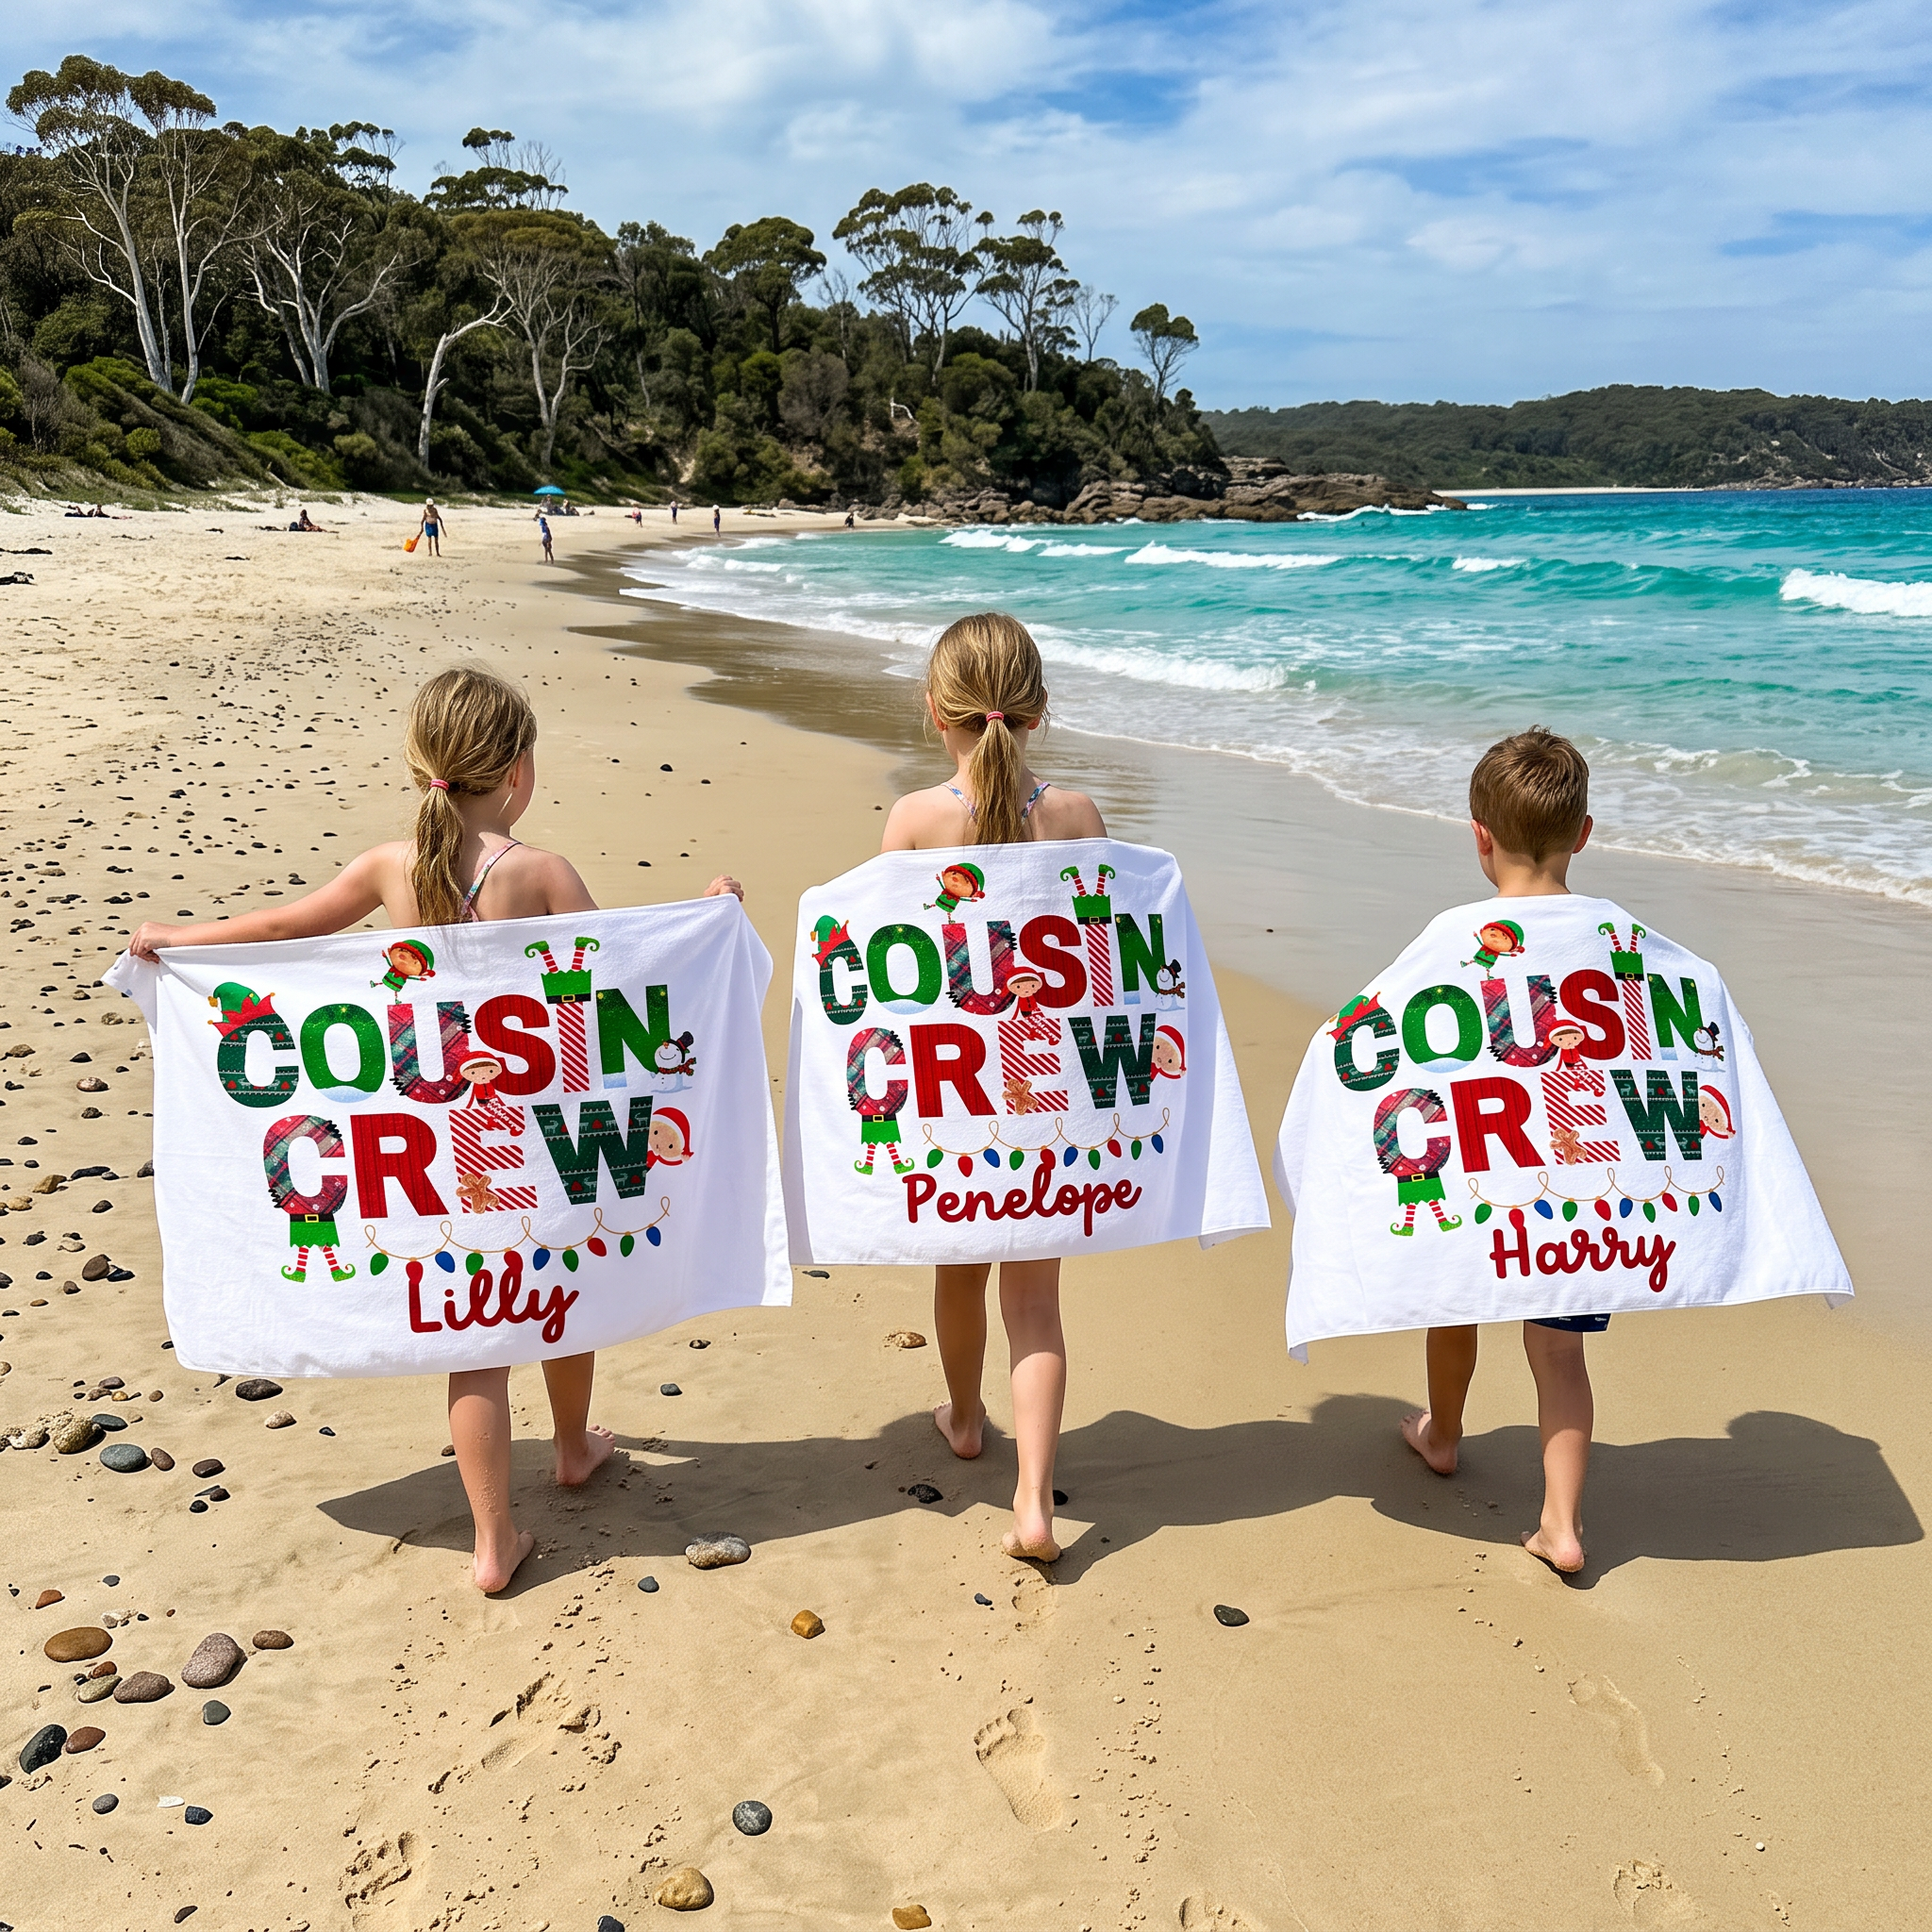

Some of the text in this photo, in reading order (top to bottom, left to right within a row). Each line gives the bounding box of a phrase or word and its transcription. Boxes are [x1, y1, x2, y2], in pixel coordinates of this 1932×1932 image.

[819, 913, 1166, 1025] COUSIN
[217, 985, 672, 1108] COUSIN
[847, 1013, 1157, 1118] CREW
[1334, 969, 1702, 1091] COUSIN
[263, 1095, 653, 1220] CREW
[1374, 1069, 1703, 1176] CREW
[902, 1160, 1142, 1237] Penelope
[408, 1269, 579, 1343] Lilly
[1490, 1227, 1676, 1292] Harry
